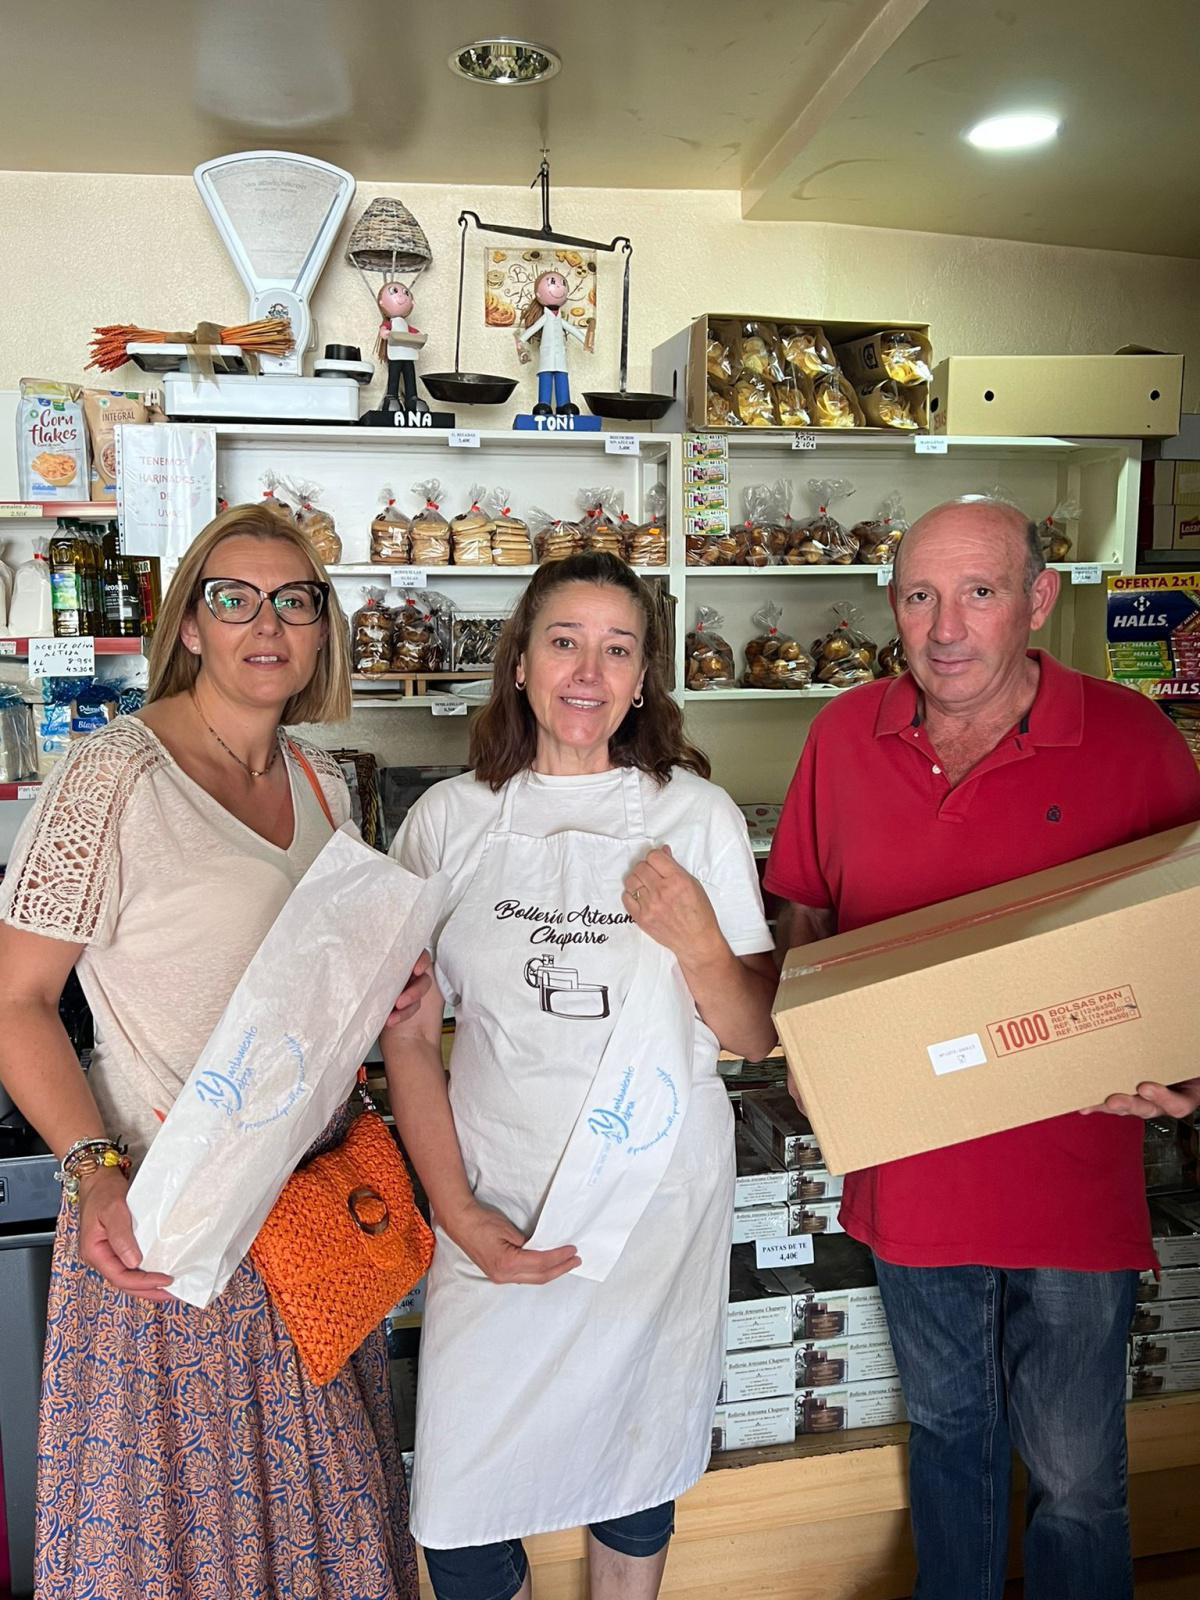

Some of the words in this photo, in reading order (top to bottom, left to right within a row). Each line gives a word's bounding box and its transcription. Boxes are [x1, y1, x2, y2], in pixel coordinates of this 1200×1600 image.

[40, 408, 74, 427] Corn
[102, 411, 135, 422] INTEGRAL
[394, 411, 433, 428] ANA
[28, 424, 77, 446] flakes
[1114, 577, 1168, 589] OFERTA
[567, 904, 637, 927] Artesan
[530, 925, 609, 951] Chaparro
[1049, 998, 1097, 1018] BOLSAS
[1098, 990, 1122, 1003] PAN
[995, 1013, 1050, 1050] 1000
[762, 1245, 787, 1253] PASTAS
[779, 1251, 798, 1261] 4,40€
